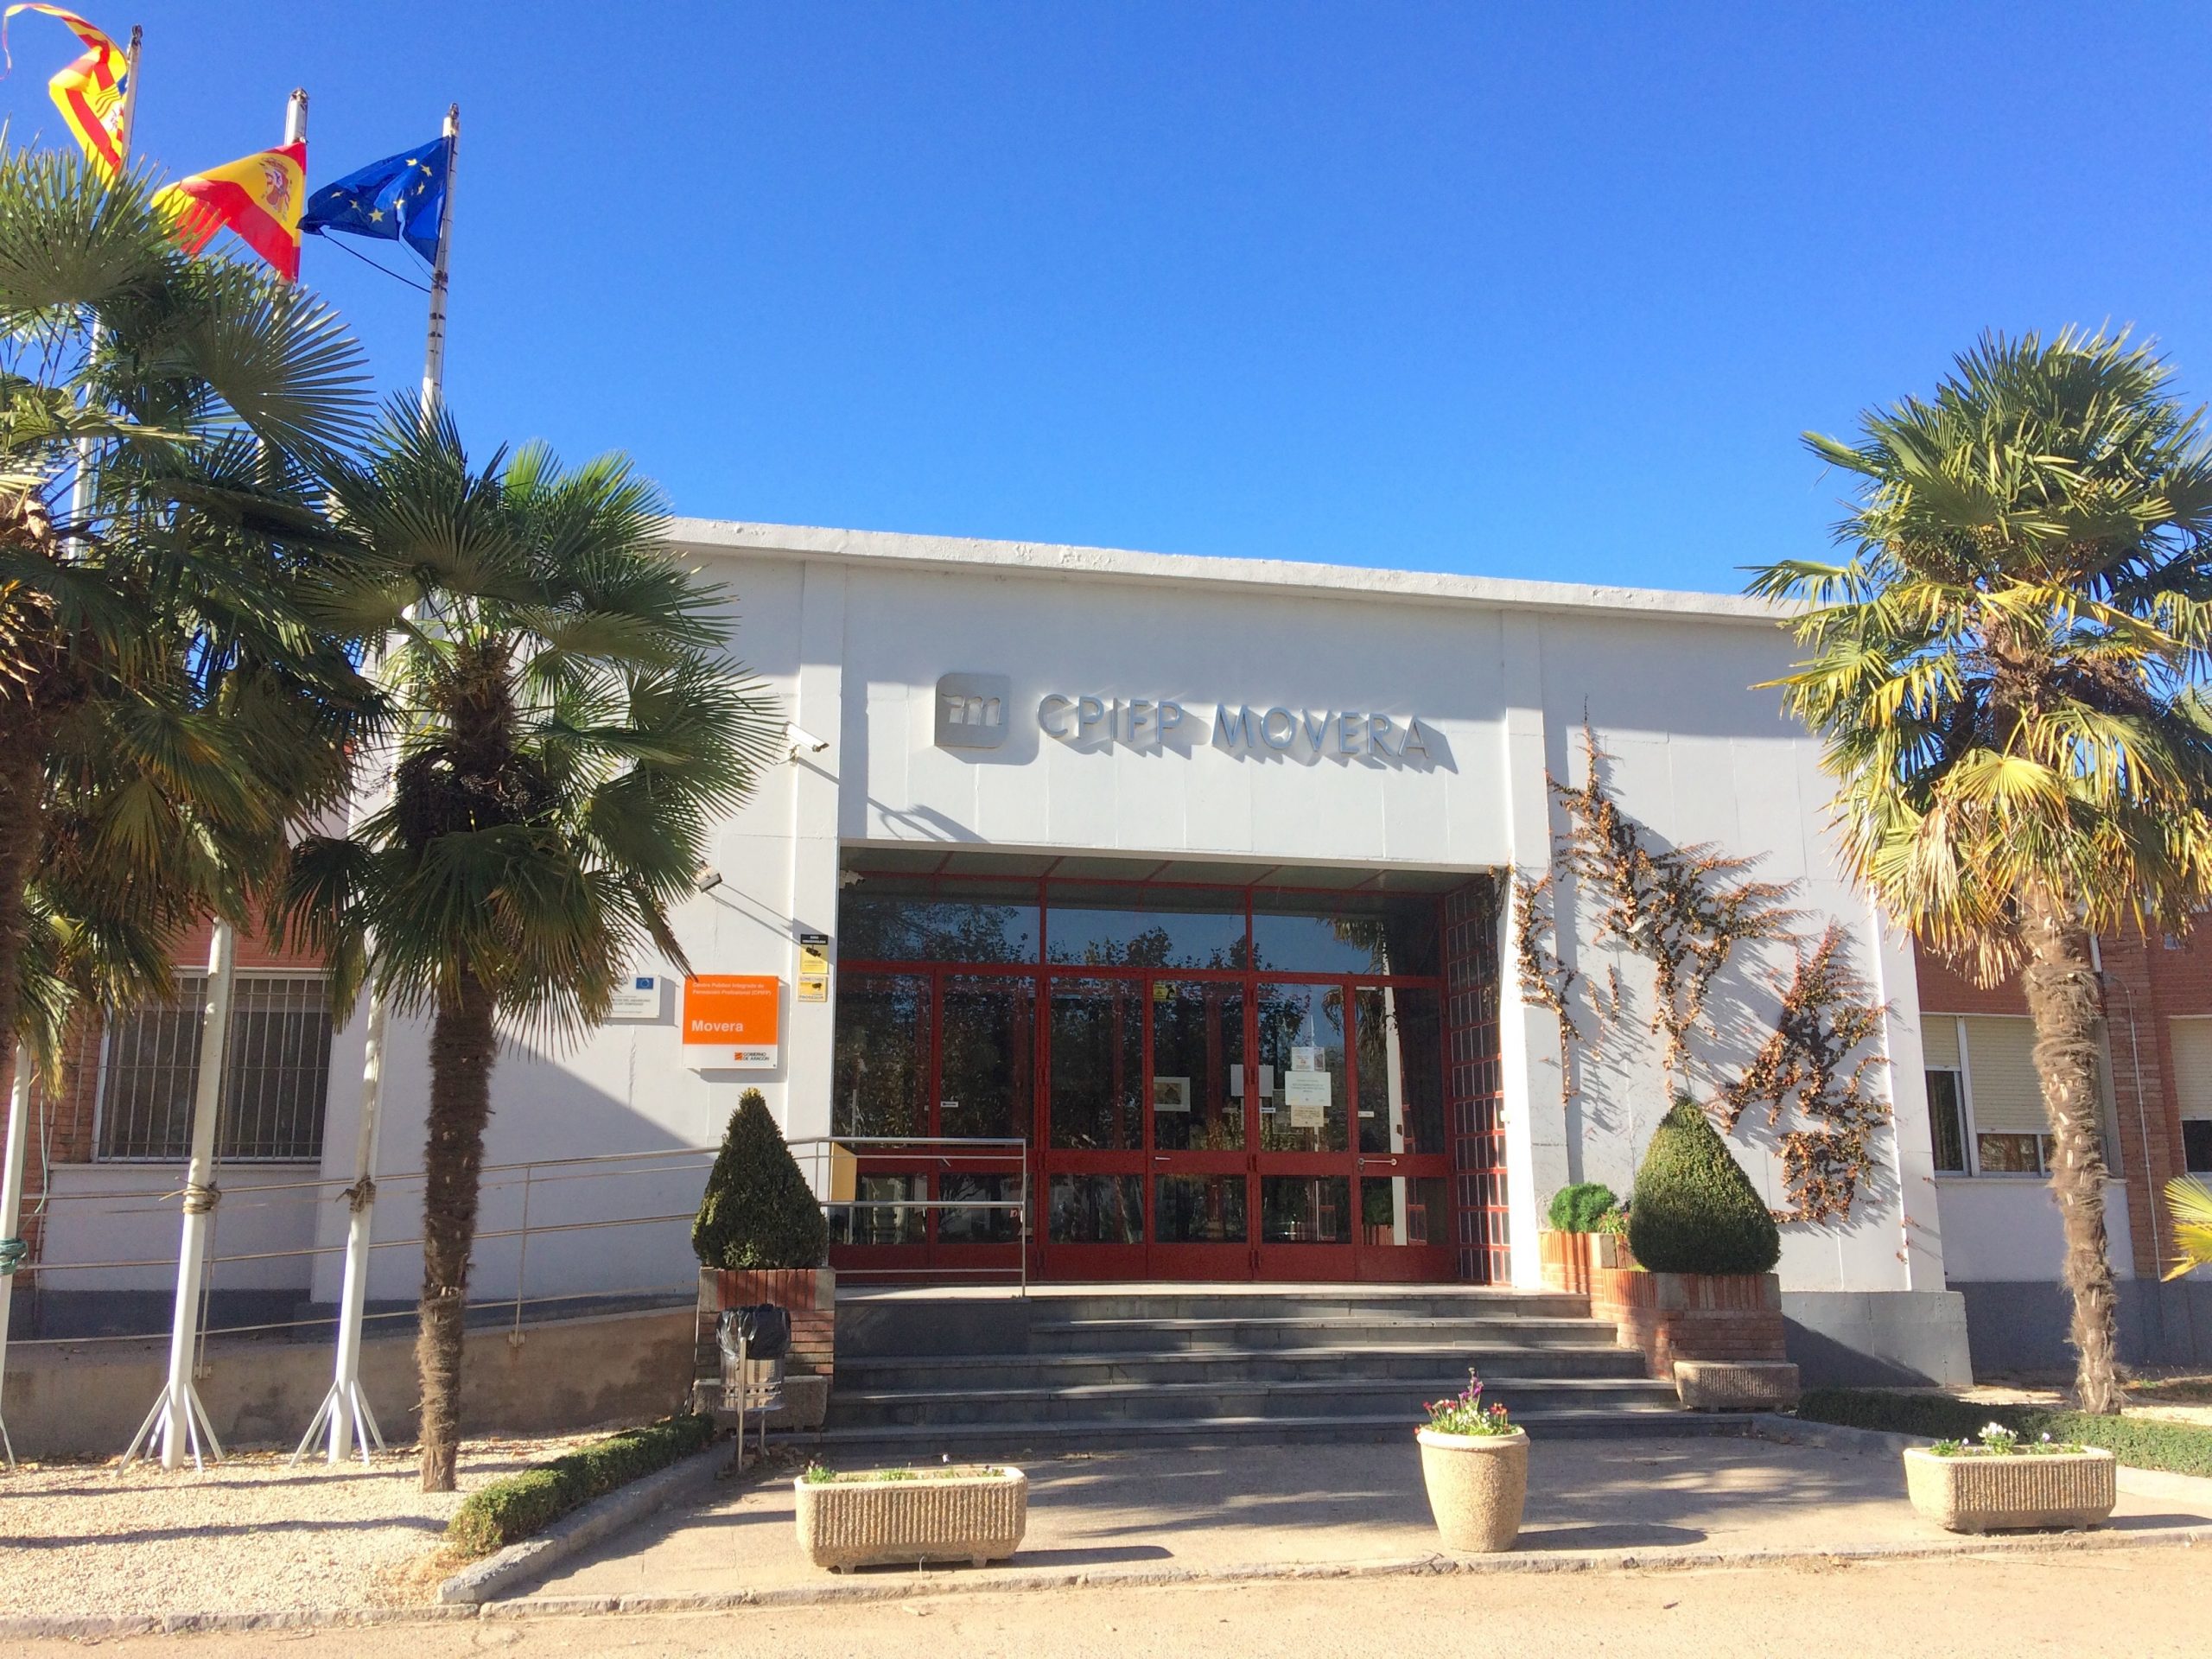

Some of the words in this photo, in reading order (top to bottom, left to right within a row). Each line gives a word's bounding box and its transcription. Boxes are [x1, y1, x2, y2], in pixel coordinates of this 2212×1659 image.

[1038, 693, 1183, 744] CPIFP
[1211, 702, 1430, 760] MOVERA
[691, 1020, 743, 1033] Movera
